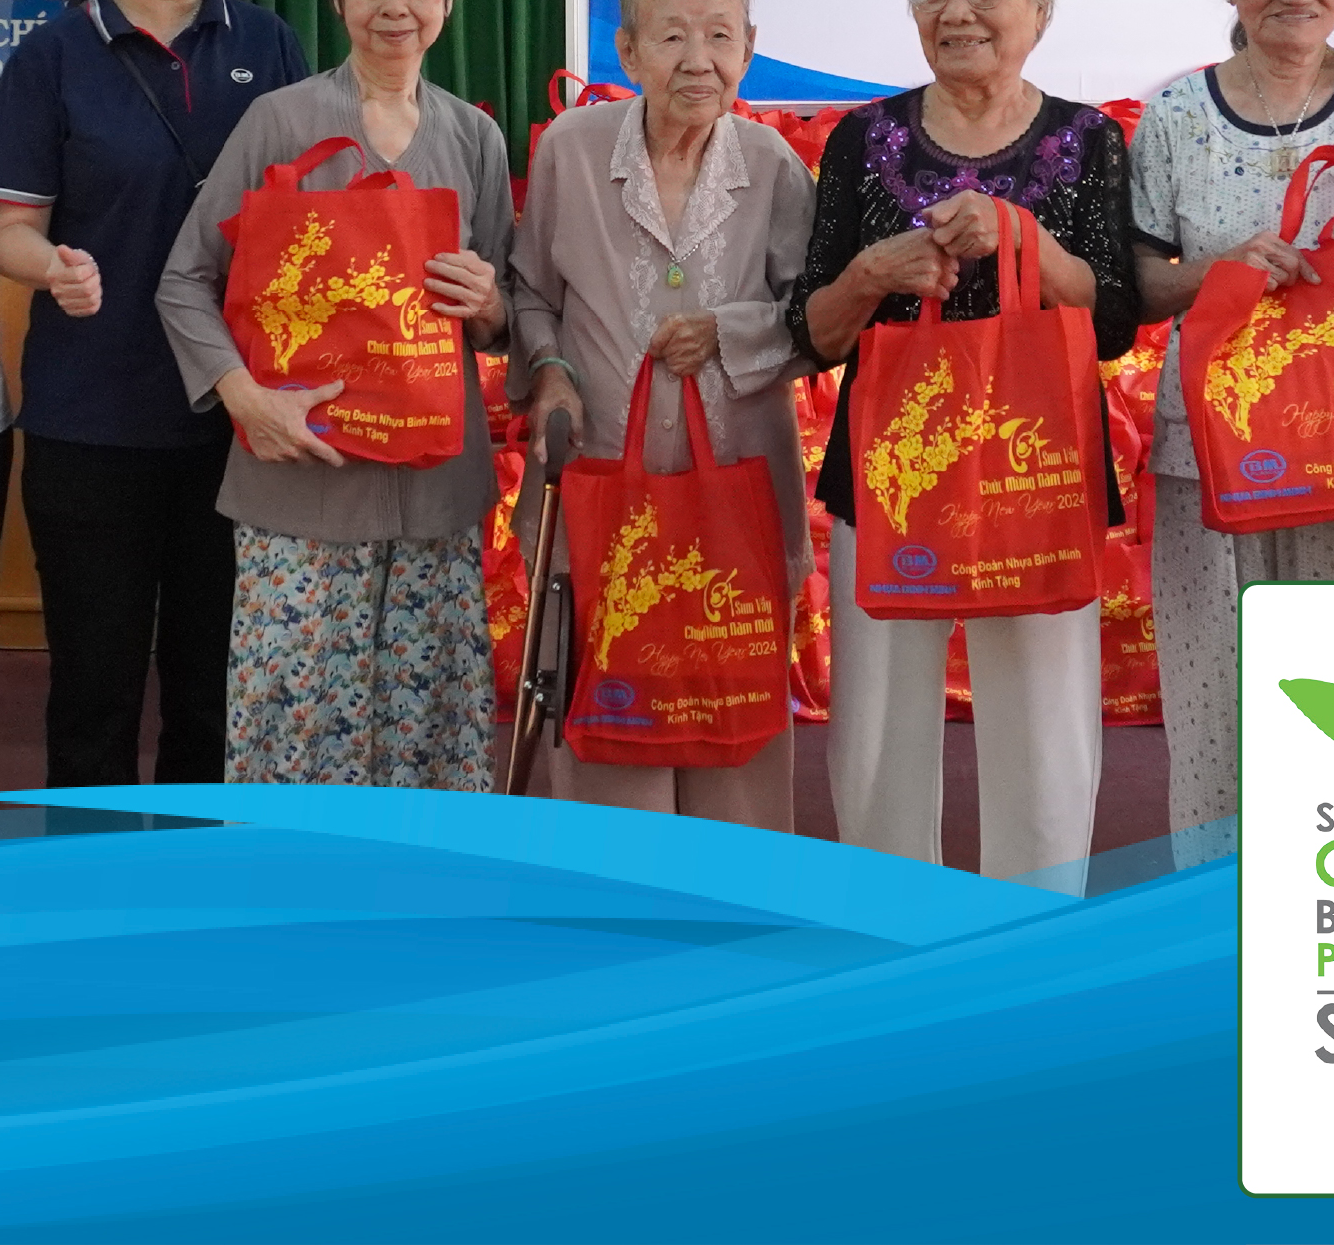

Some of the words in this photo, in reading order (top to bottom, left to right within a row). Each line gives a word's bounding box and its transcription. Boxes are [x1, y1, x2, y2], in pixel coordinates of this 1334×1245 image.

[434, 362, 458, 377] 2024
[1305, 463, 1332, 475] Công
[1057, 493, 1084, 509] 2024
[951, 563, 977, 577] Công
[978, 561, 1003, 573] Đoàn
[1006, 557, 1032, 571] Nhựa
[1034, 552, 1056, 566] Bình
[1059, 548, 1081, 560] Minh
[995, 575, 1021, 589] Tặng
[748, 641, 777, 656] 2024
